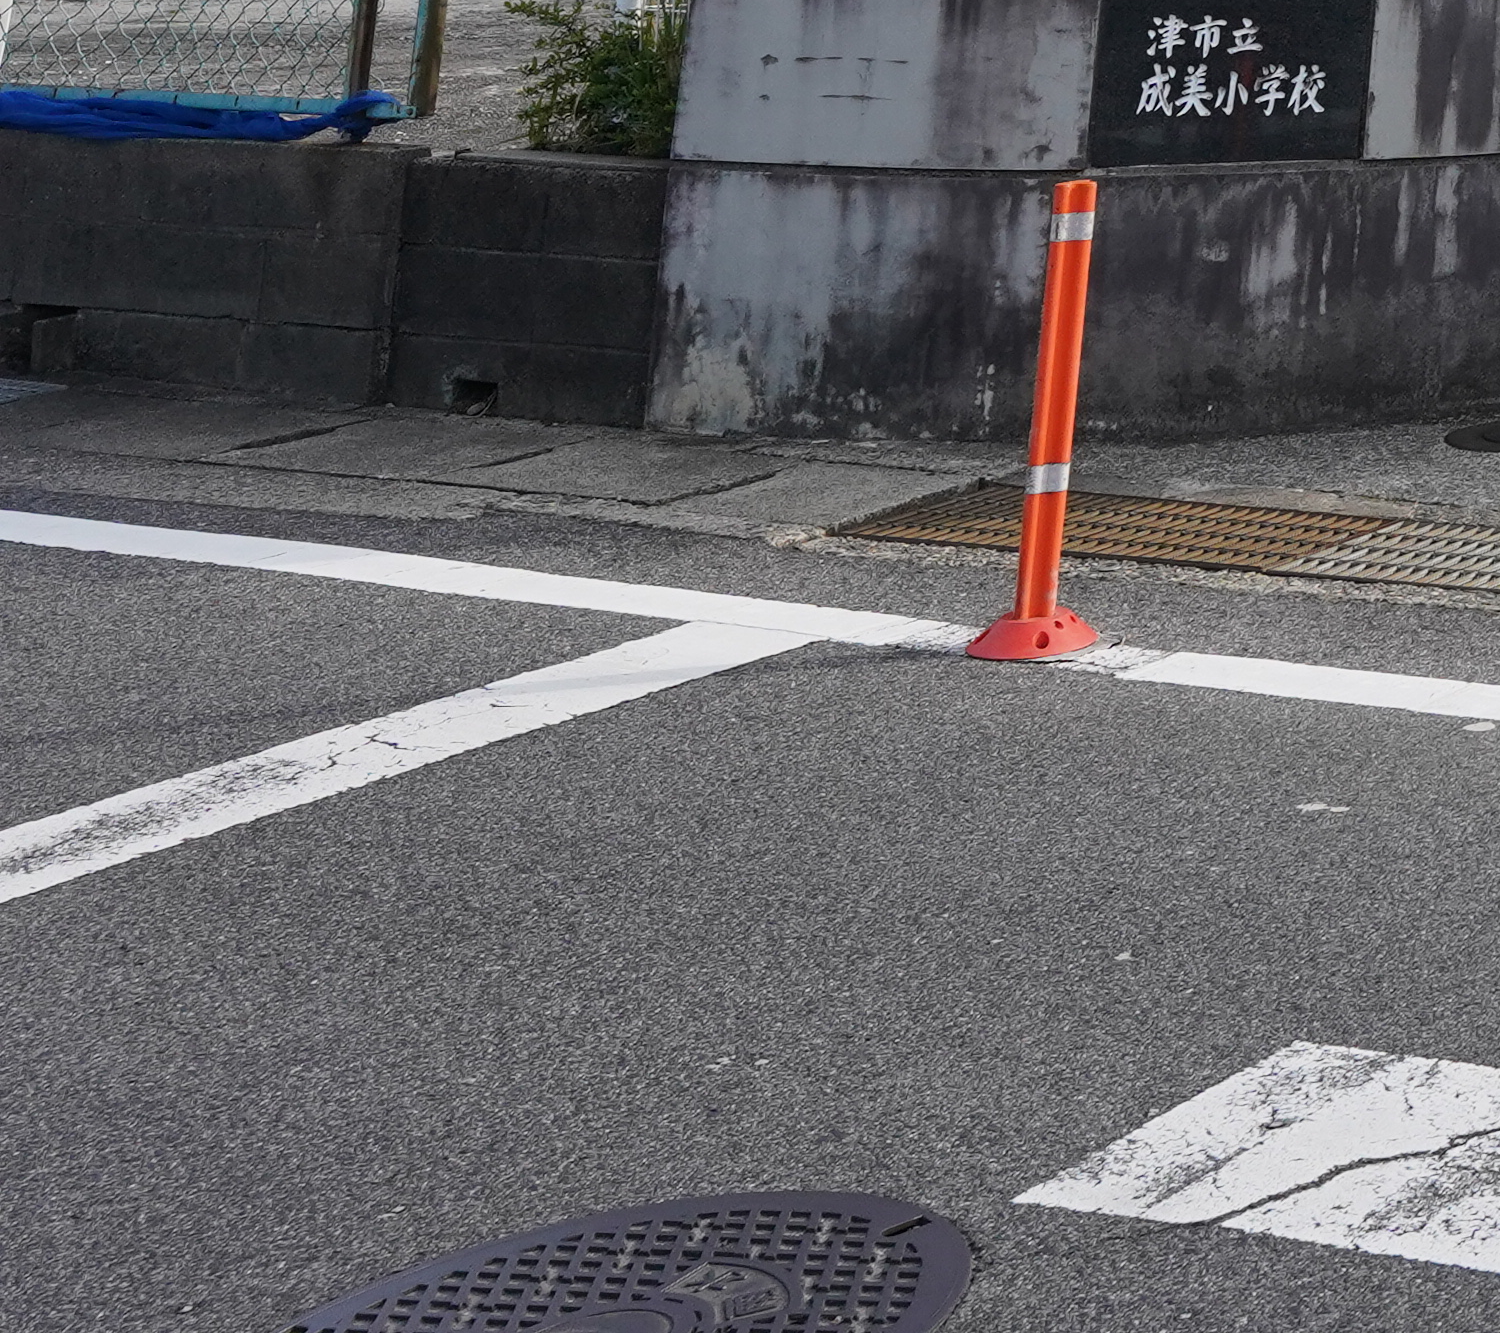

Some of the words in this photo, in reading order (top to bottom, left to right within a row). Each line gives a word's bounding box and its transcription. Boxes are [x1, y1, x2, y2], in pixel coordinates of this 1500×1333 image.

[1146, 14, 1264, 59] 津市立
[1135, 62, 1327, 117] 成美小学校
